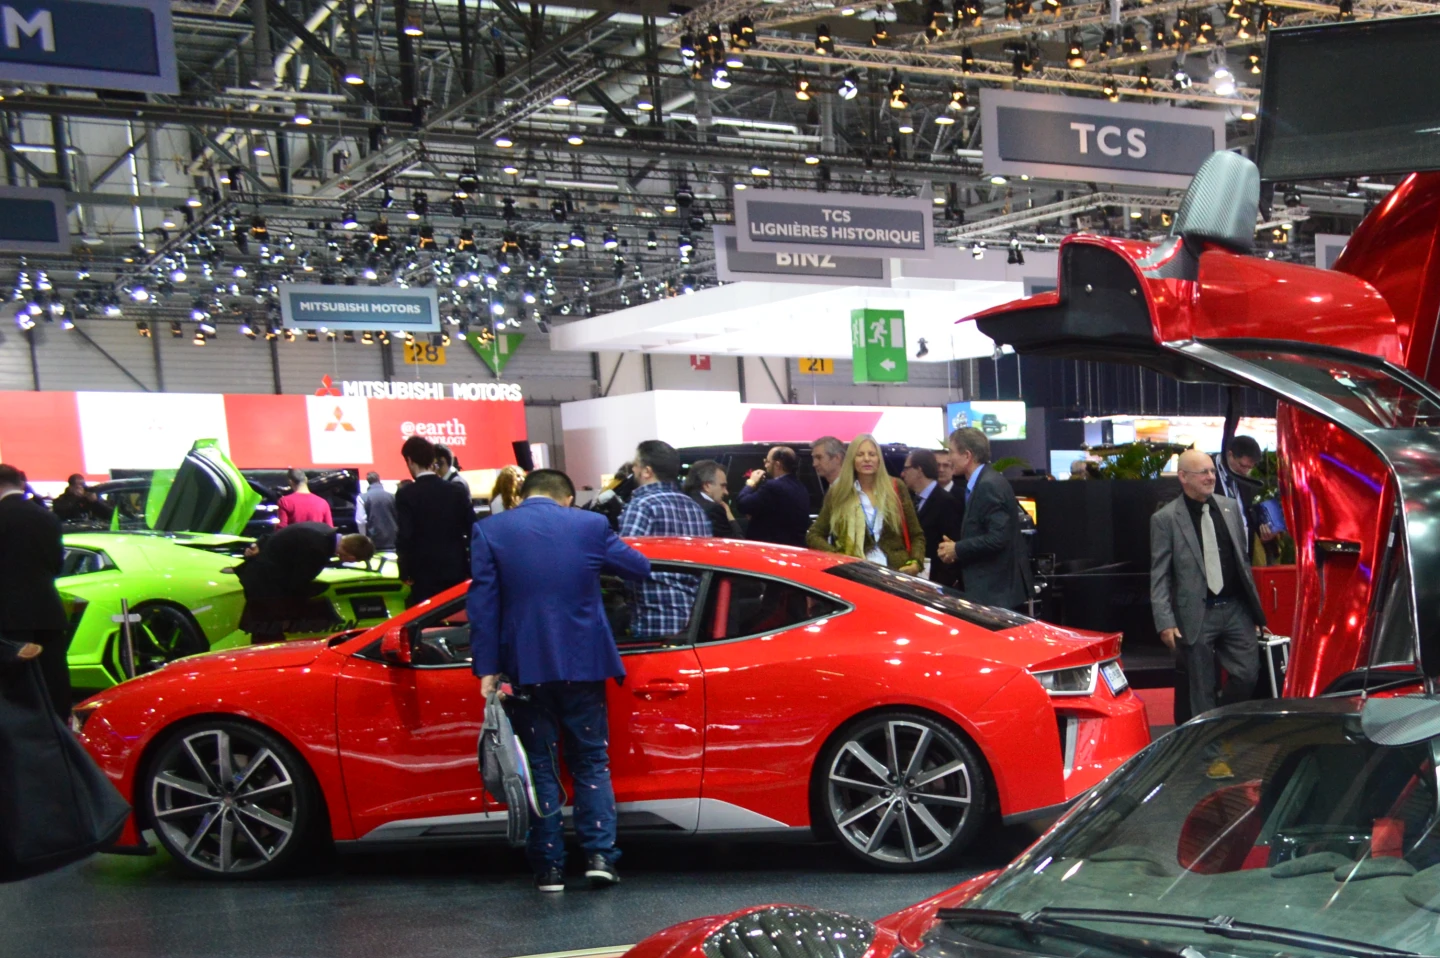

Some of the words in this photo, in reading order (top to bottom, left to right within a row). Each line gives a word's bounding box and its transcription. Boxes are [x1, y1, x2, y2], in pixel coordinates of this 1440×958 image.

[1070, 122, 1147, 158] TCS
[821, 209, 851, 222] TCS
[751, 221, 828, 239] LIGNIÈRES
[831, 227, 920, 244] HISTORIQUE
[300, 302, 369, 313] MITSUBISHI
[371, 304, 421, 314] MOTORS
[410, 342, 439, 362] 28
[807, 358, 824, 372] 21
[342, 381, 444, 400] MITSUBISHI
[452, 382, 522, 401] MOTORS
[401, 418, 466, 436] @earth
